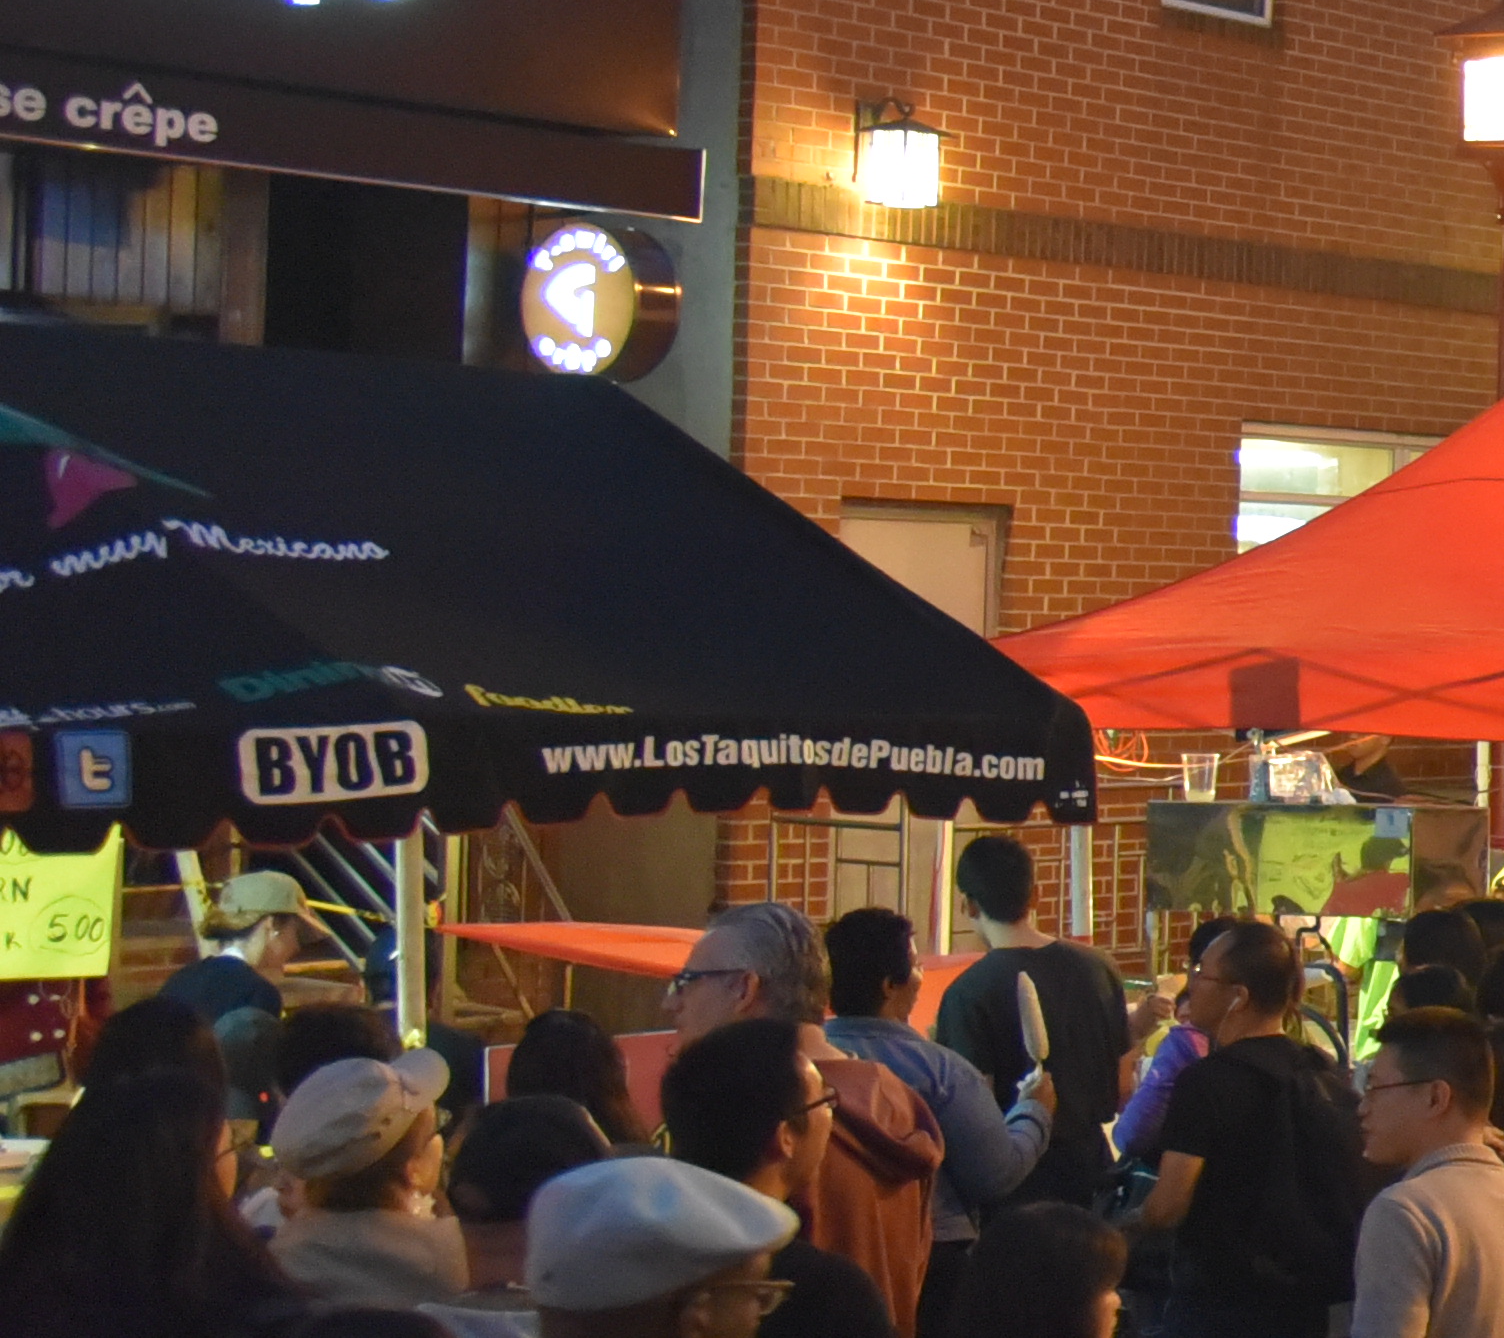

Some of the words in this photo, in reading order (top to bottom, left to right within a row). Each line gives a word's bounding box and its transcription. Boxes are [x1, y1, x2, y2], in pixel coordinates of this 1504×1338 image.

[65, 81, 219, 147] crêpe
[254, 728, 417, 798] BYOB
[542, 733, 1045, 782] www.LosTaquitosdePuebla.com
